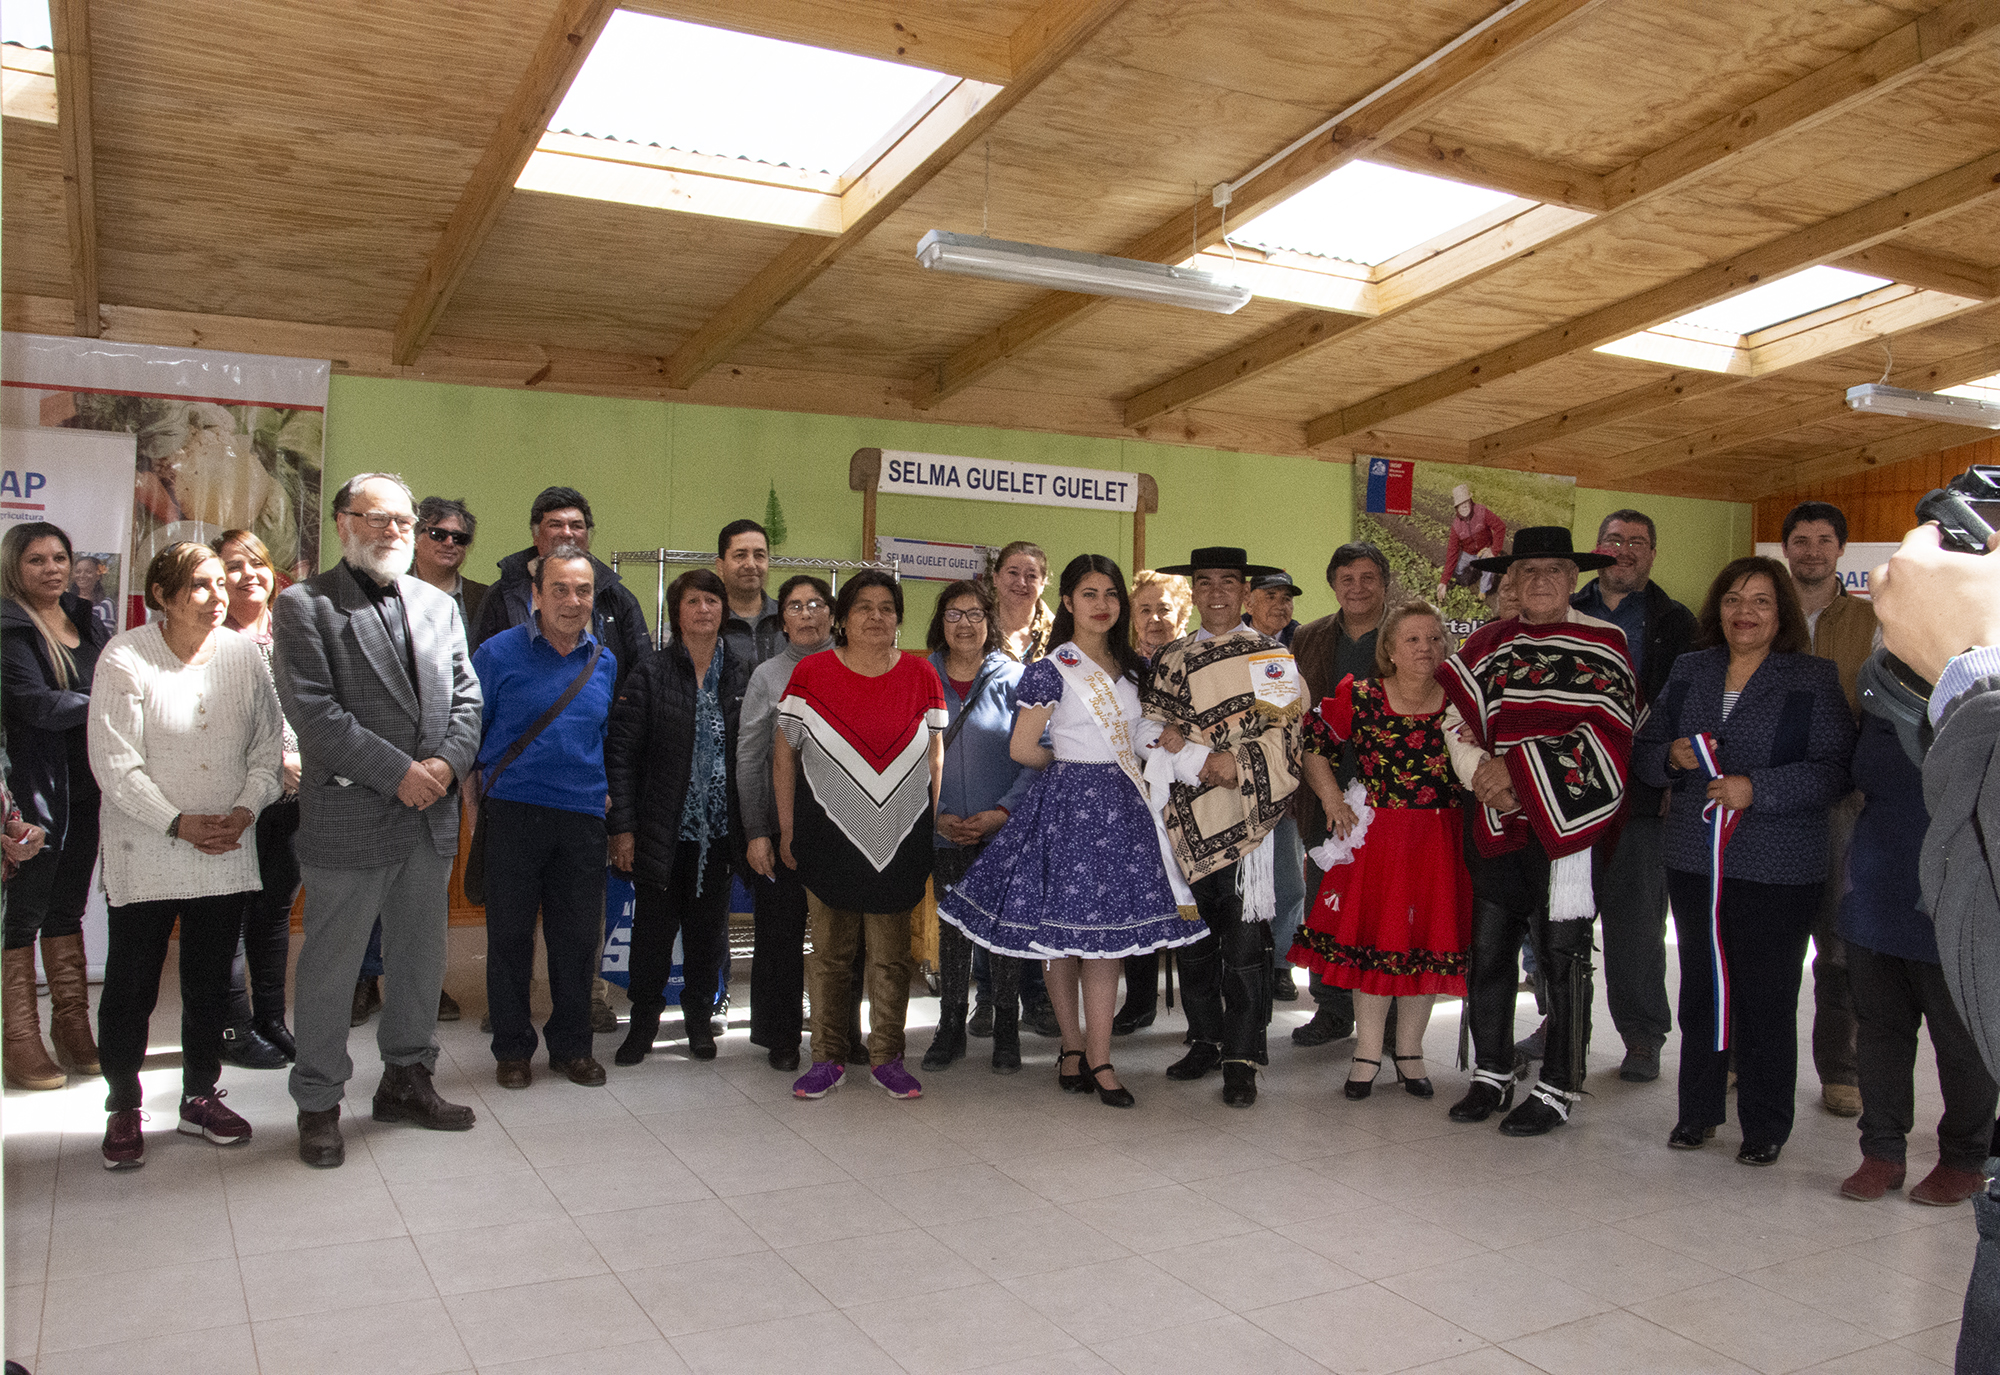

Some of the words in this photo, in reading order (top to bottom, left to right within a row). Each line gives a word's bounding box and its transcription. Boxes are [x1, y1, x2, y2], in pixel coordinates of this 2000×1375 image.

[888, 459, 961, 488] SELMA
[966, 467, 1047, 495] GUELET
[1052, 475, 1128, 503] GUELET
[886, 552, 914, 565] SELMA
[916, 555, 947, 567] GUELET
[948, 559, 978, 570] GUELET
